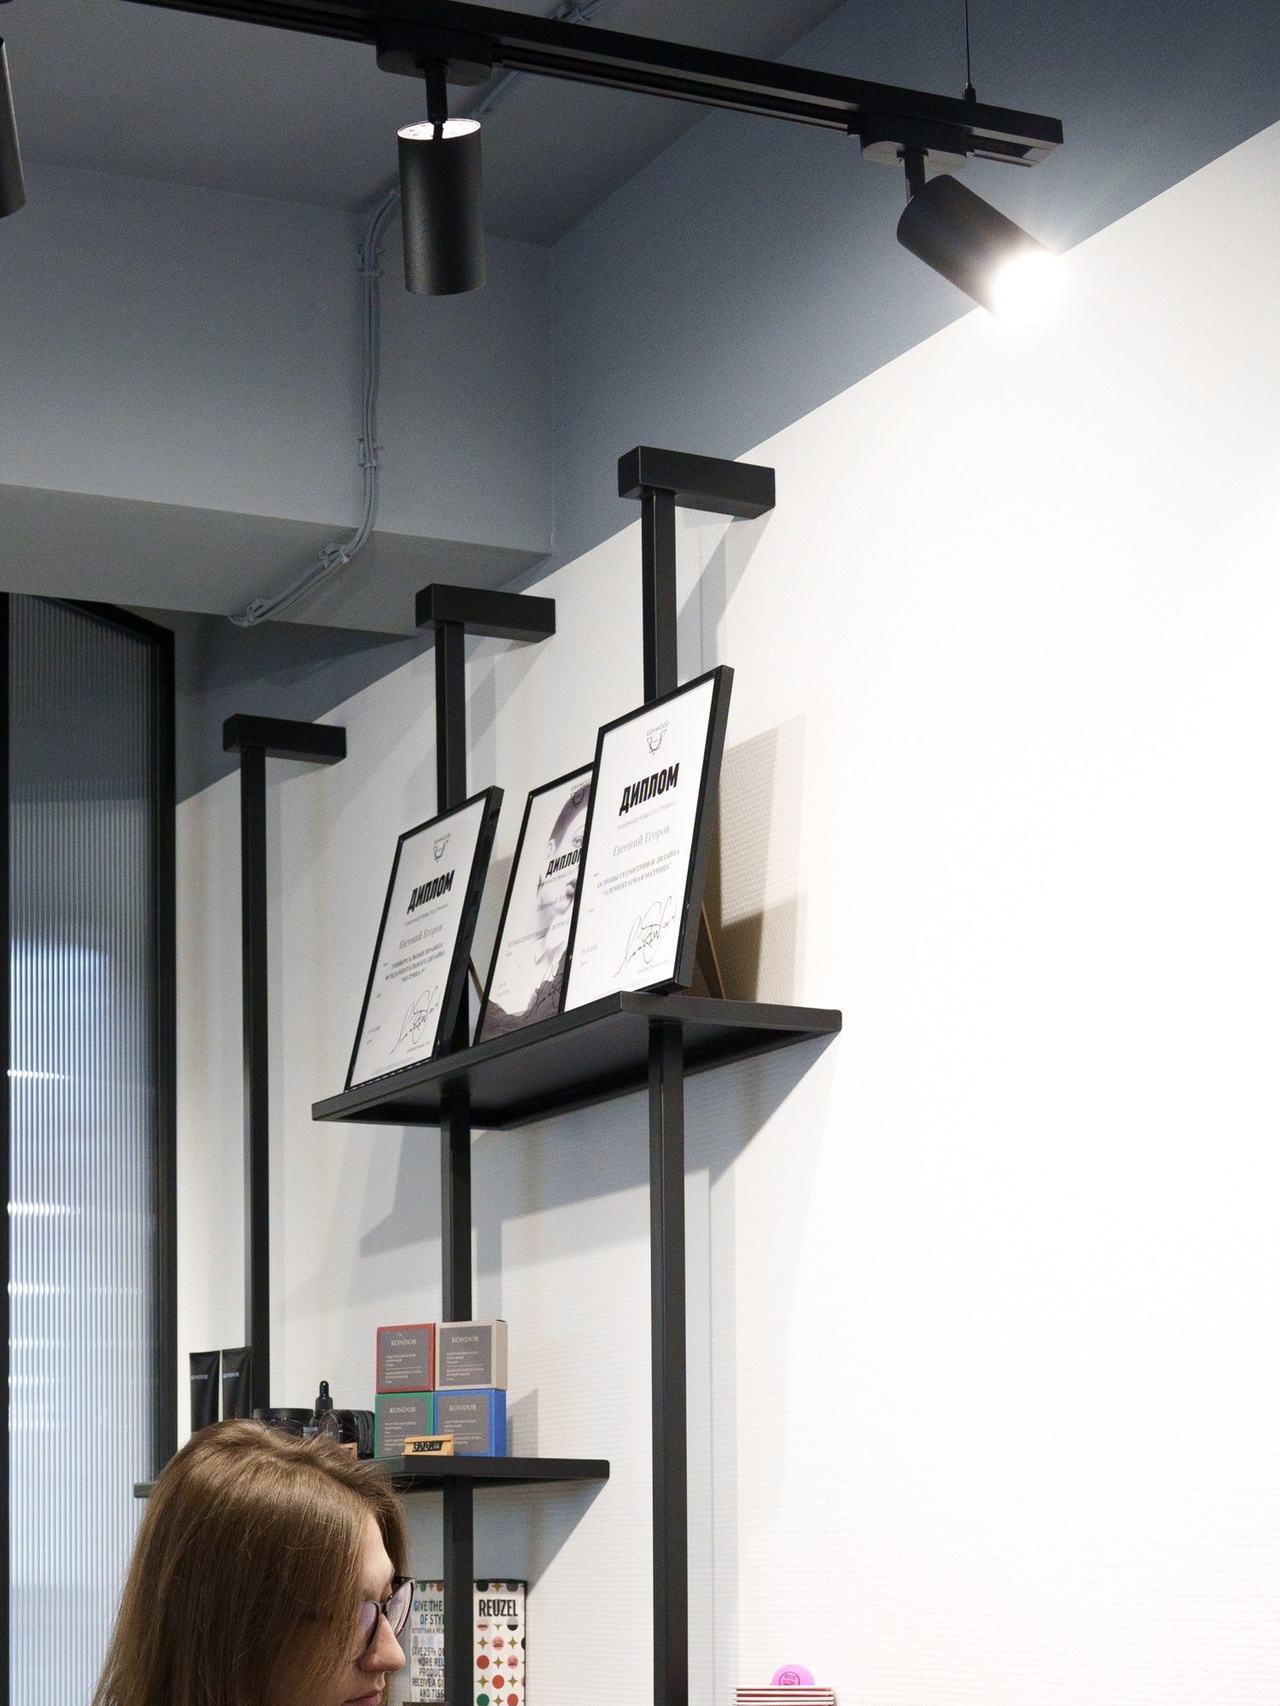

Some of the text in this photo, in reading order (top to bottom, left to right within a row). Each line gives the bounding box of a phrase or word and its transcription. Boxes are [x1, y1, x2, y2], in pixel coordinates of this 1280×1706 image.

[619, 762, 680, 816] ДИПЛОМ
[407, 869, 455, 915] ДИПЛОМ
[391, 1339, 417, 1347] KONDOR
[389, 1406, 416, 1414] KONDOR
[449, 1404, 477, 1412] KONDOR
[429, 1600, 443, 1612] THE
[478, 1599, 518, 1617] REUZEL
[420, 1614, 428, 1625] OF
[431, 1689, 444, 1698] TISS
